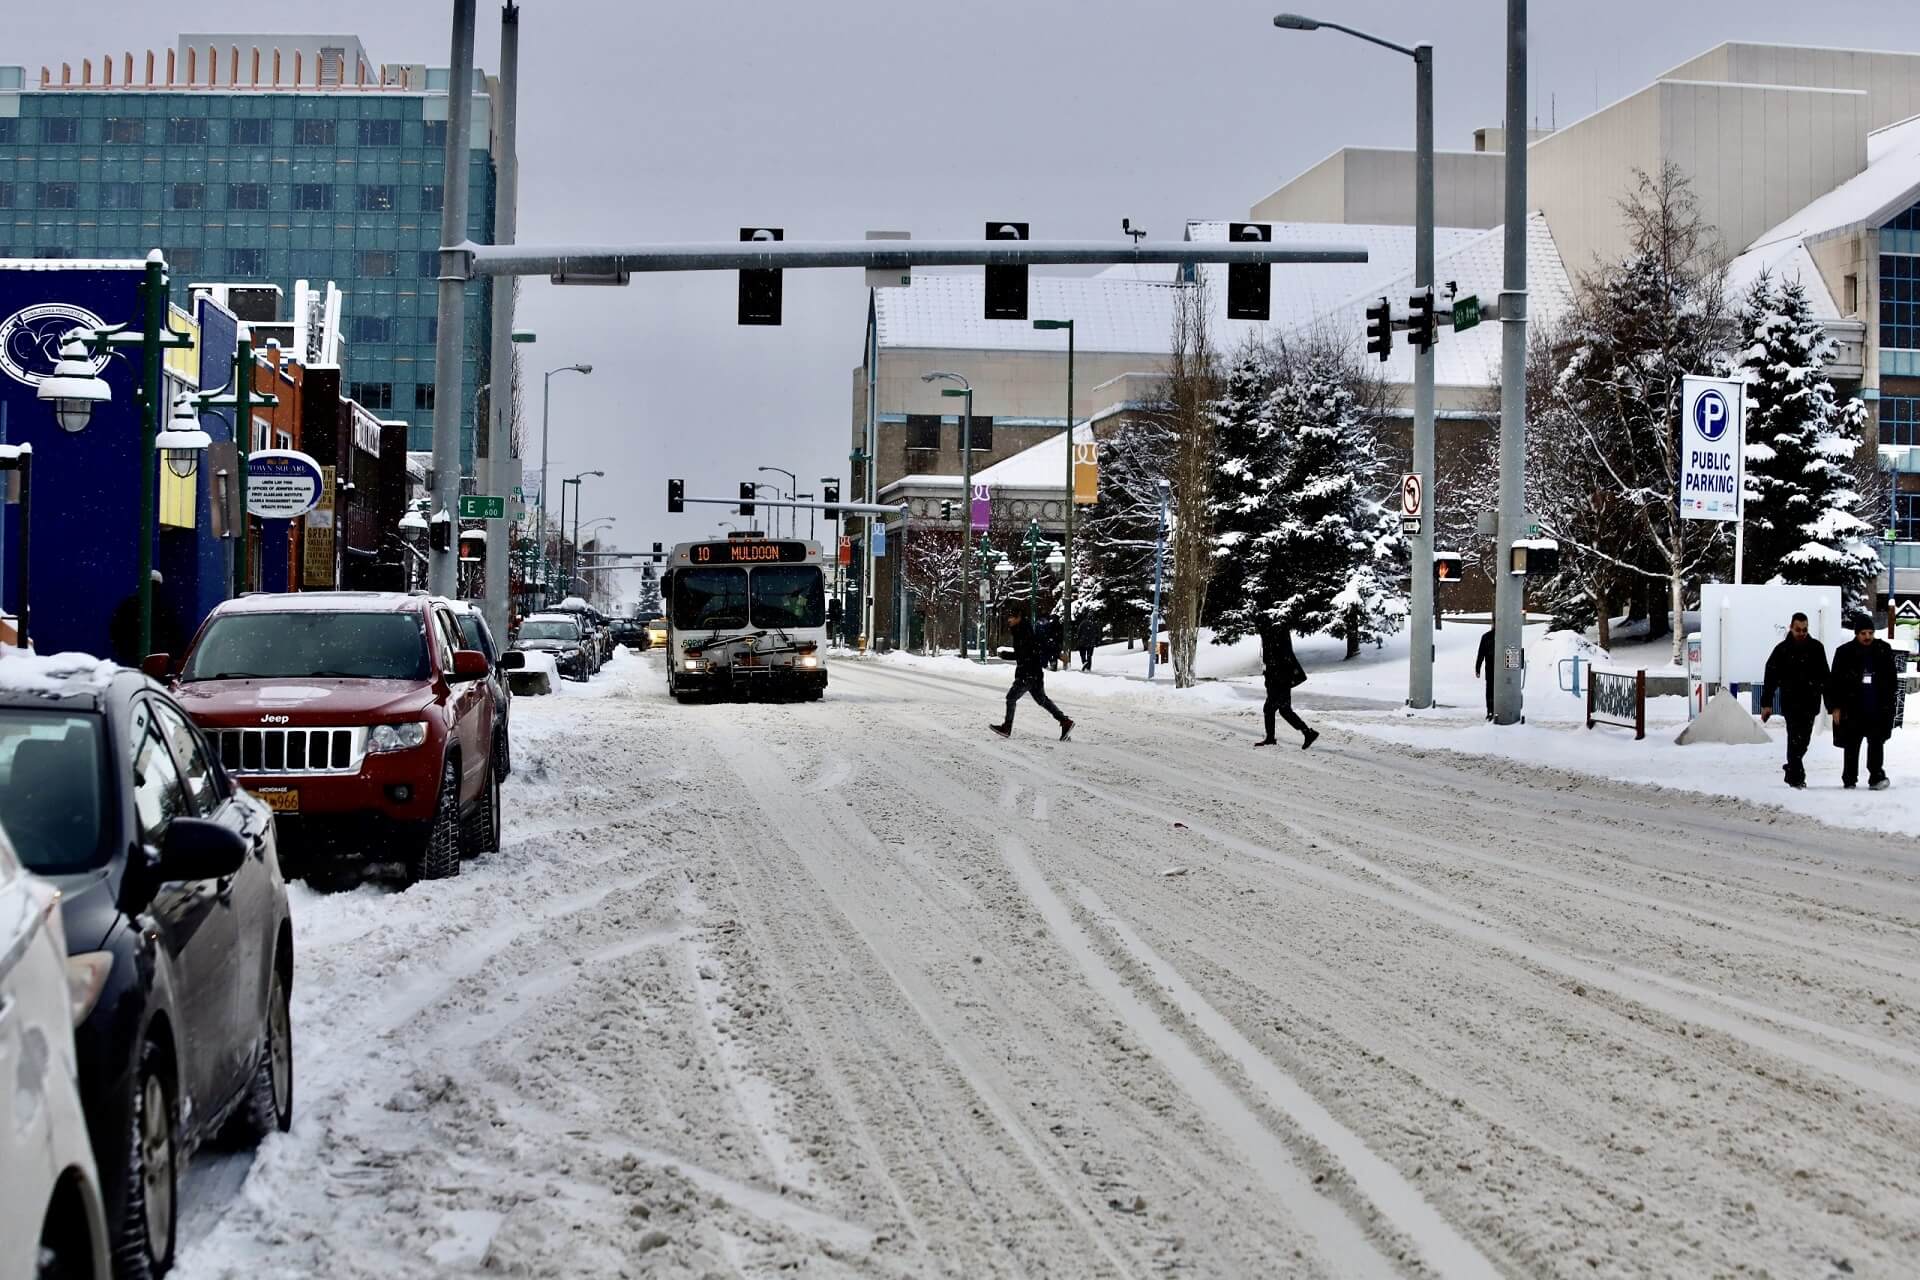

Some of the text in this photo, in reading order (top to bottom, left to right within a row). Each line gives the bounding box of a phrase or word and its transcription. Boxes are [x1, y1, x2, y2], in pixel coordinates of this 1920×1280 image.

[1703, 396, 1724, 434] P
[1691, 450, 1731, 471] PUBLIC
[249, 464, 306, 473] TOWN SQUARE
[1685, 473, 1734, 493] PARKING
[468, 500, 476, 513] E
[484, 508, 498, 517] 600
[307, 528, 331, 538] GREAT
[697, 546, 779, 561] 10 MULDOON
[261, 714, 289, 724] Jeep
